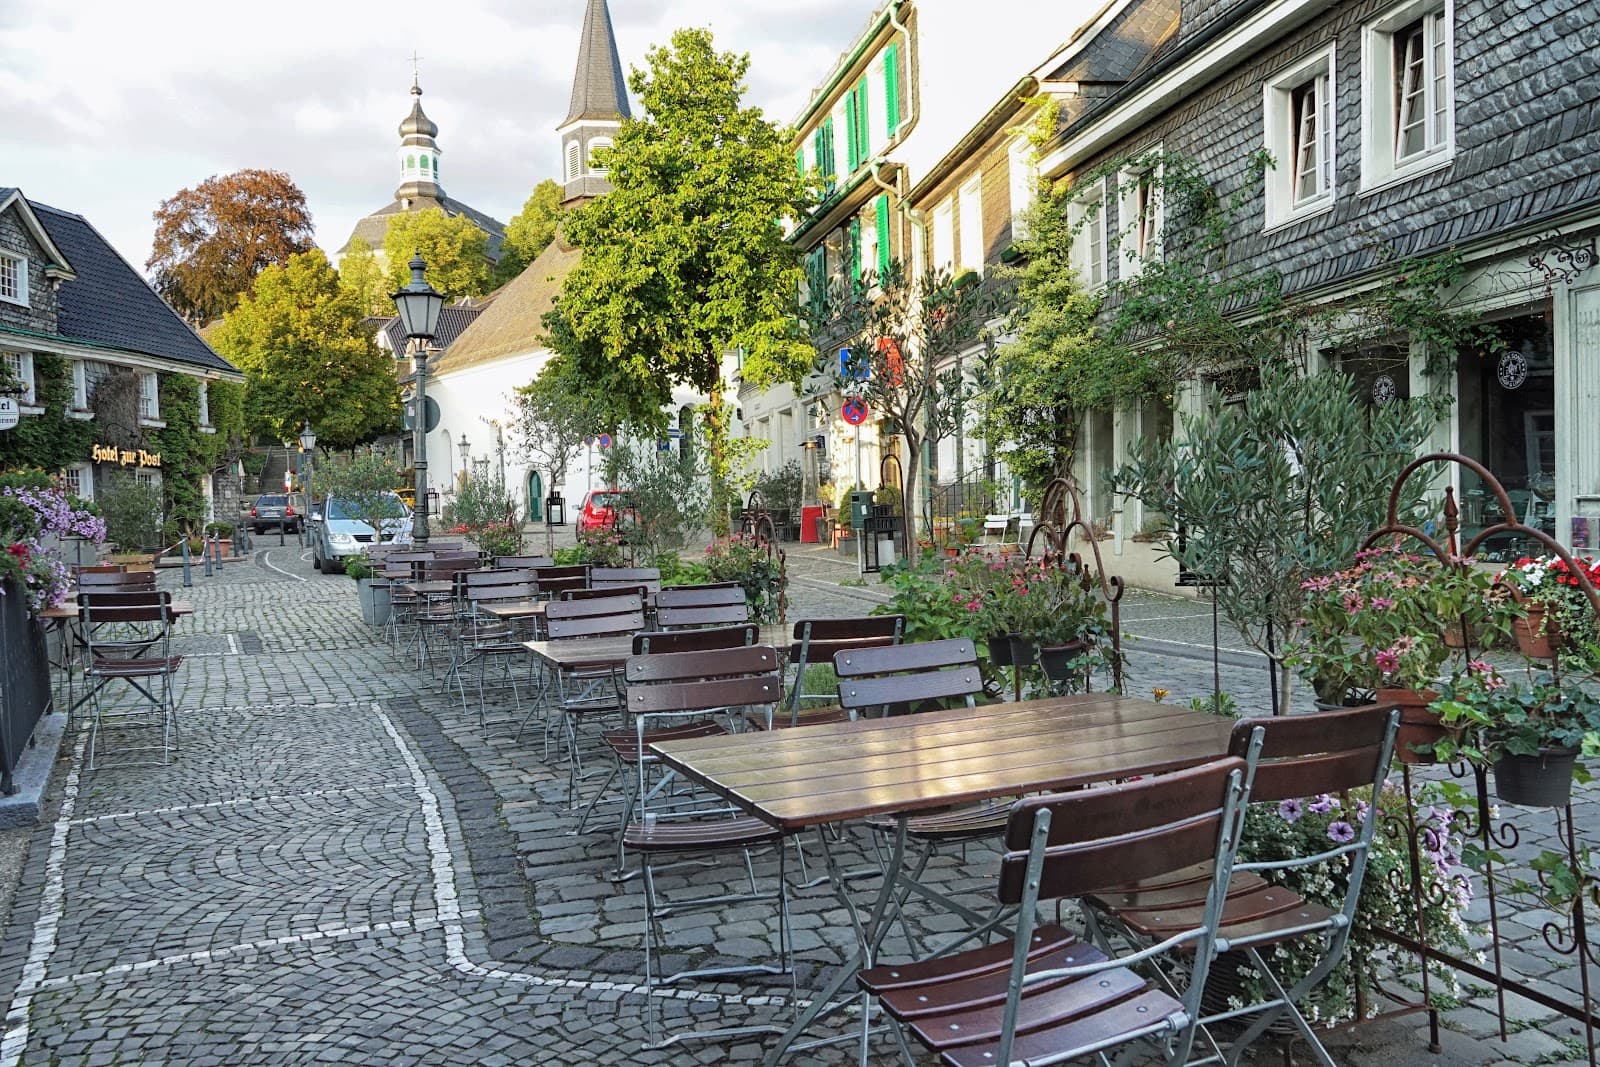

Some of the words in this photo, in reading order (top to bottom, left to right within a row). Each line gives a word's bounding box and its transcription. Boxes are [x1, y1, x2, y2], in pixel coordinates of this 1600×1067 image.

[91, 444, 119, 464] Hotel
[120, 450, 137, 466] zur
[138, 449, 161, 468] Post
